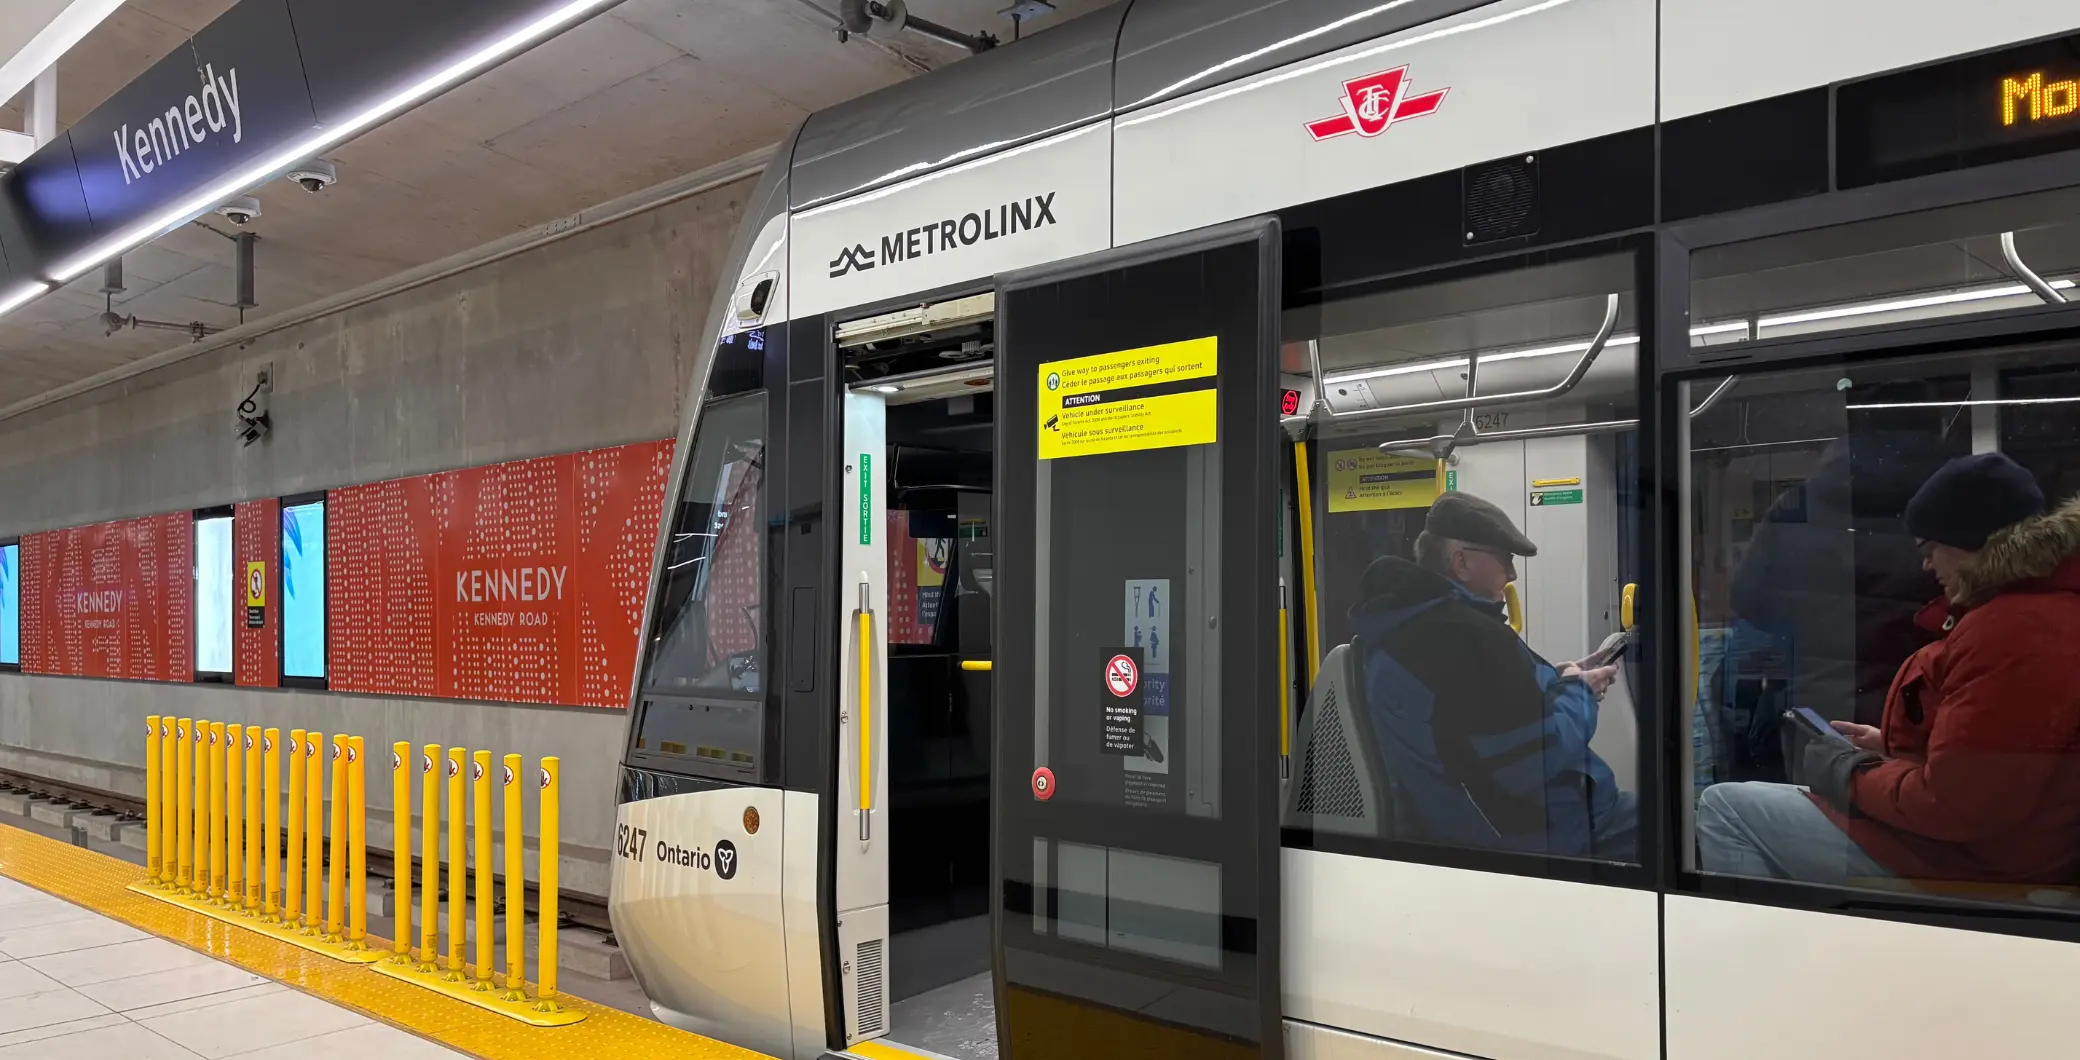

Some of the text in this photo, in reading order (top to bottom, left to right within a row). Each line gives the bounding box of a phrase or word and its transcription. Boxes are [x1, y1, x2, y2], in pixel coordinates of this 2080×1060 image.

[2003, 73, 2080, 125] Mo
[113, 63, 241, 185] Kennedy
[881, 191, 1057, 266] METROLINX
[1077, 367, 1089, 375] way
[1099, 360, 1135, 372] passengers
[1137, 357, 1160, 365] exiting
[1089, 376, 1114, 386] passage
[1129, 368, 1163, 380] passagers
[1164, 365, 1175, 375] qui
[1177, 362, 1203, 372] sortent
[1065, 394, 1100, 406] ATTENTION
[1062, 403, 1145, 419] Vehicle under surveillance
[1105, 424, 1144, 434] surveillance
[1476, 413, 1508, 430] 6247
[457, 566, 567, 602] KENNEDY
[77, 590, 122, 614] KENNEDY
[474, 612, 548, 626] KENNEDY ROAD
[1113, 715, 1131, 723] vaping
[1115, 707, 1137, 715] smoking
[1113, 742, 1134, 750] vapoter
[618, 823, 647, 862] 6247
[657, 841, 711, 870] Ontario
